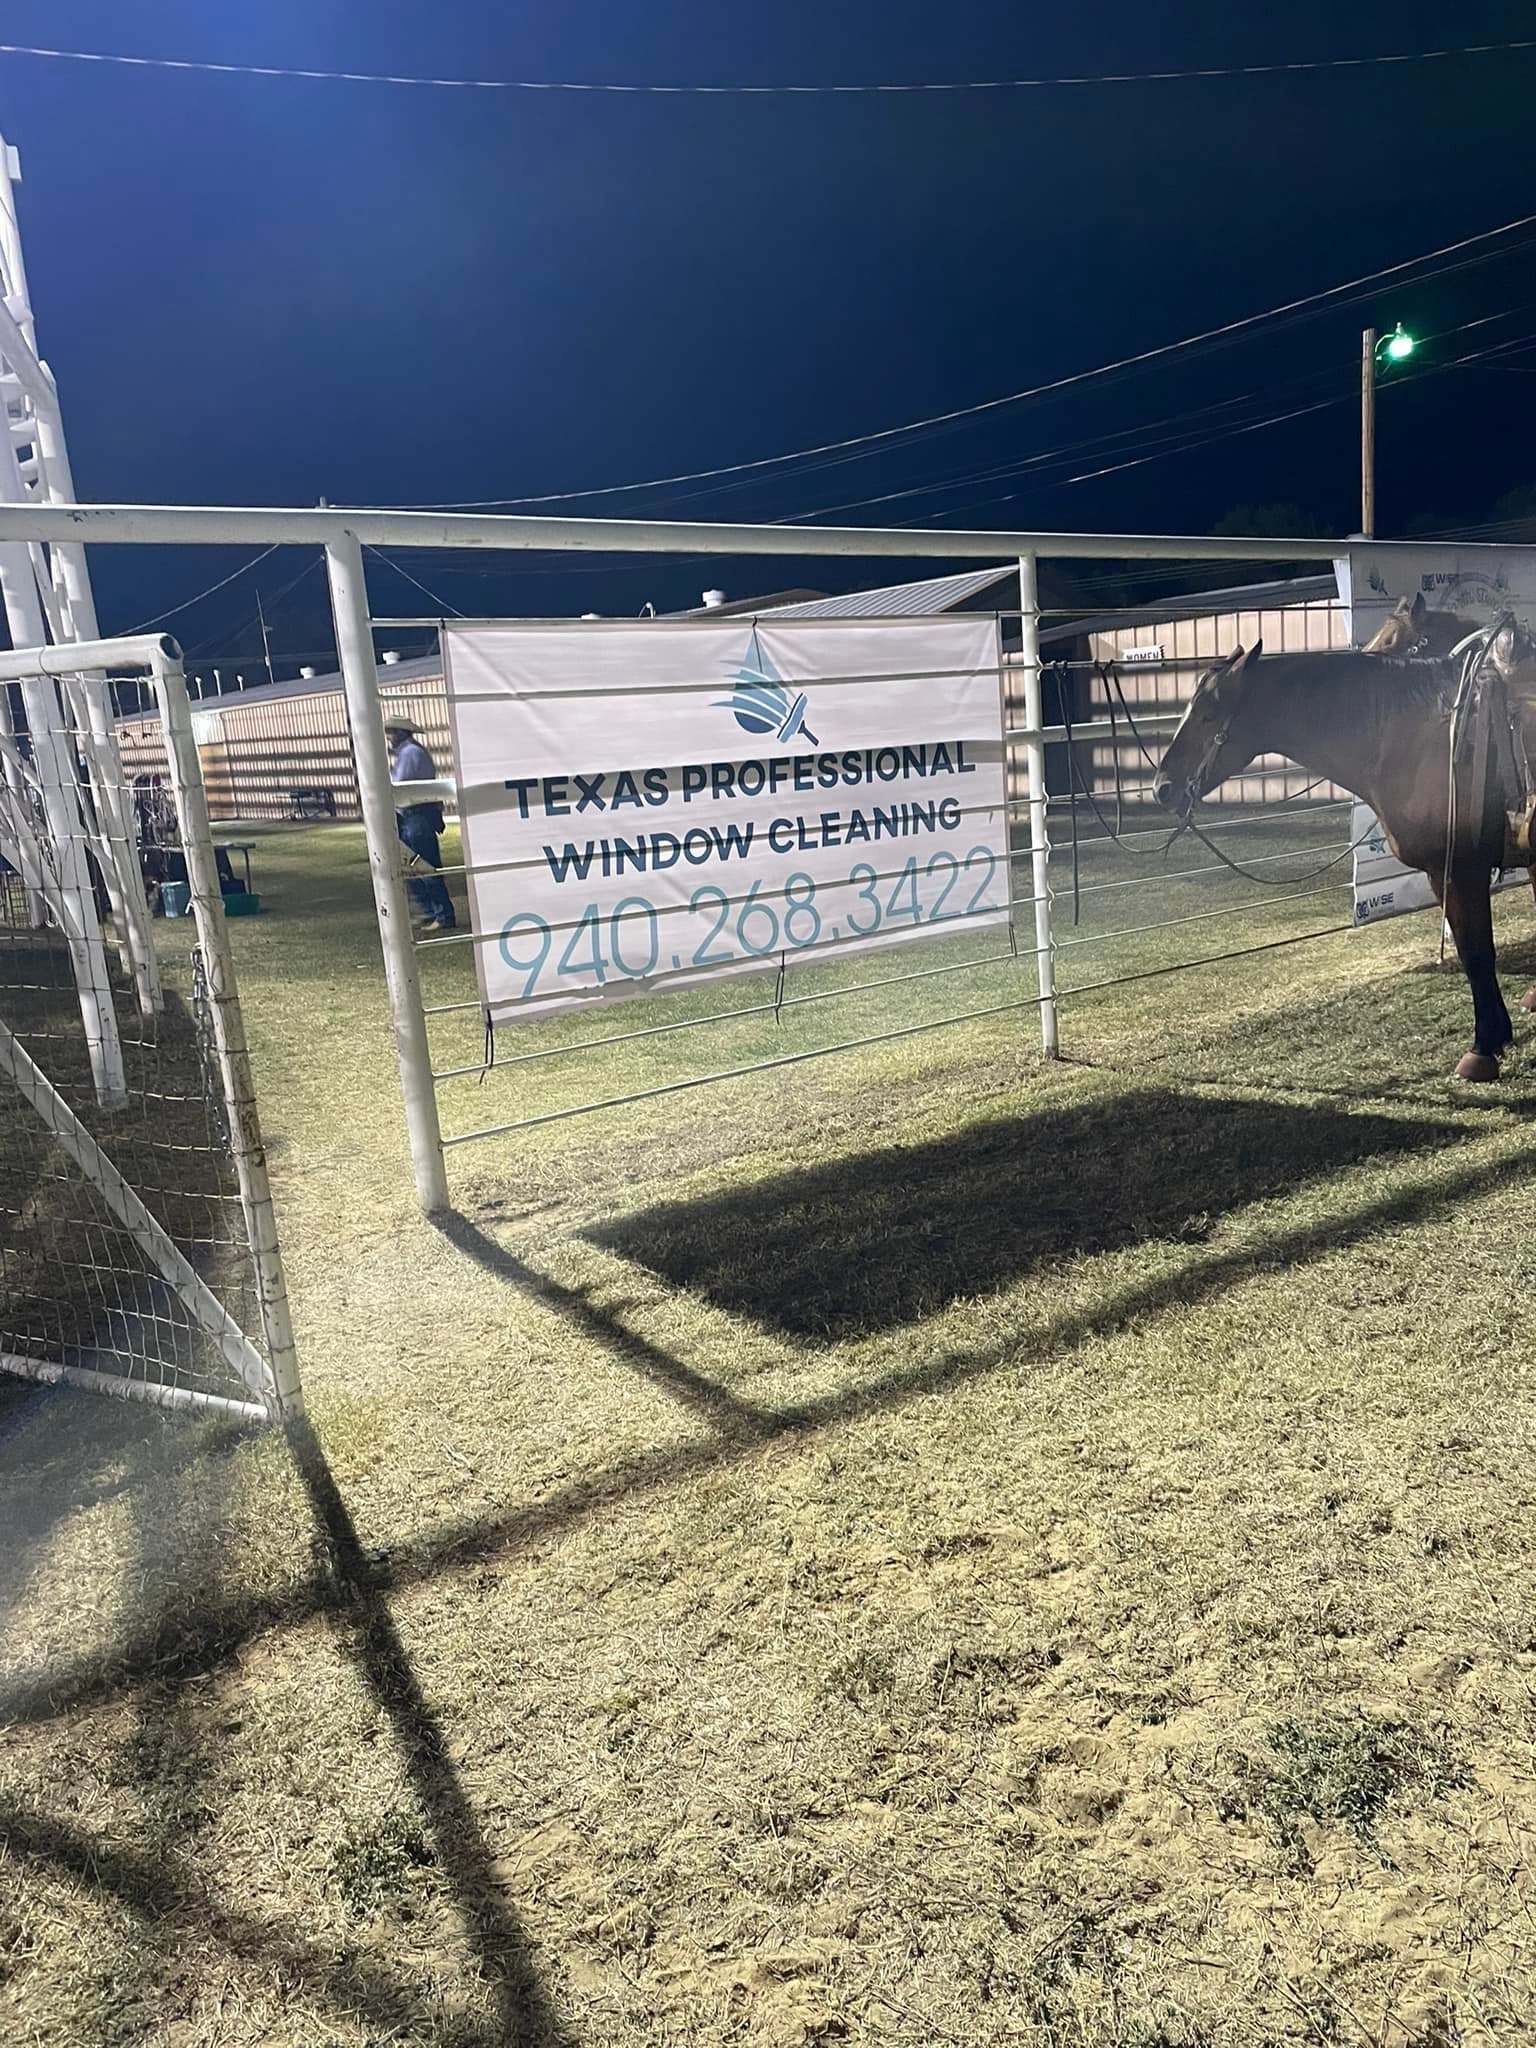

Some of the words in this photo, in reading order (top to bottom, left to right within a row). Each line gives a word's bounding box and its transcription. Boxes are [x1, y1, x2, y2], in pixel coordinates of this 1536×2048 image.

[1126, 651, 1159, 662] WOMEN
[504, 766, 670, 820] TEXAS
[682, 741, 976, 803] PROFESSIONAL
[542, 823, 755, 884] WINDOW
[769, 797, 961, 854] CLEANING
[498, 845, 998, 999] 940.268.3422
